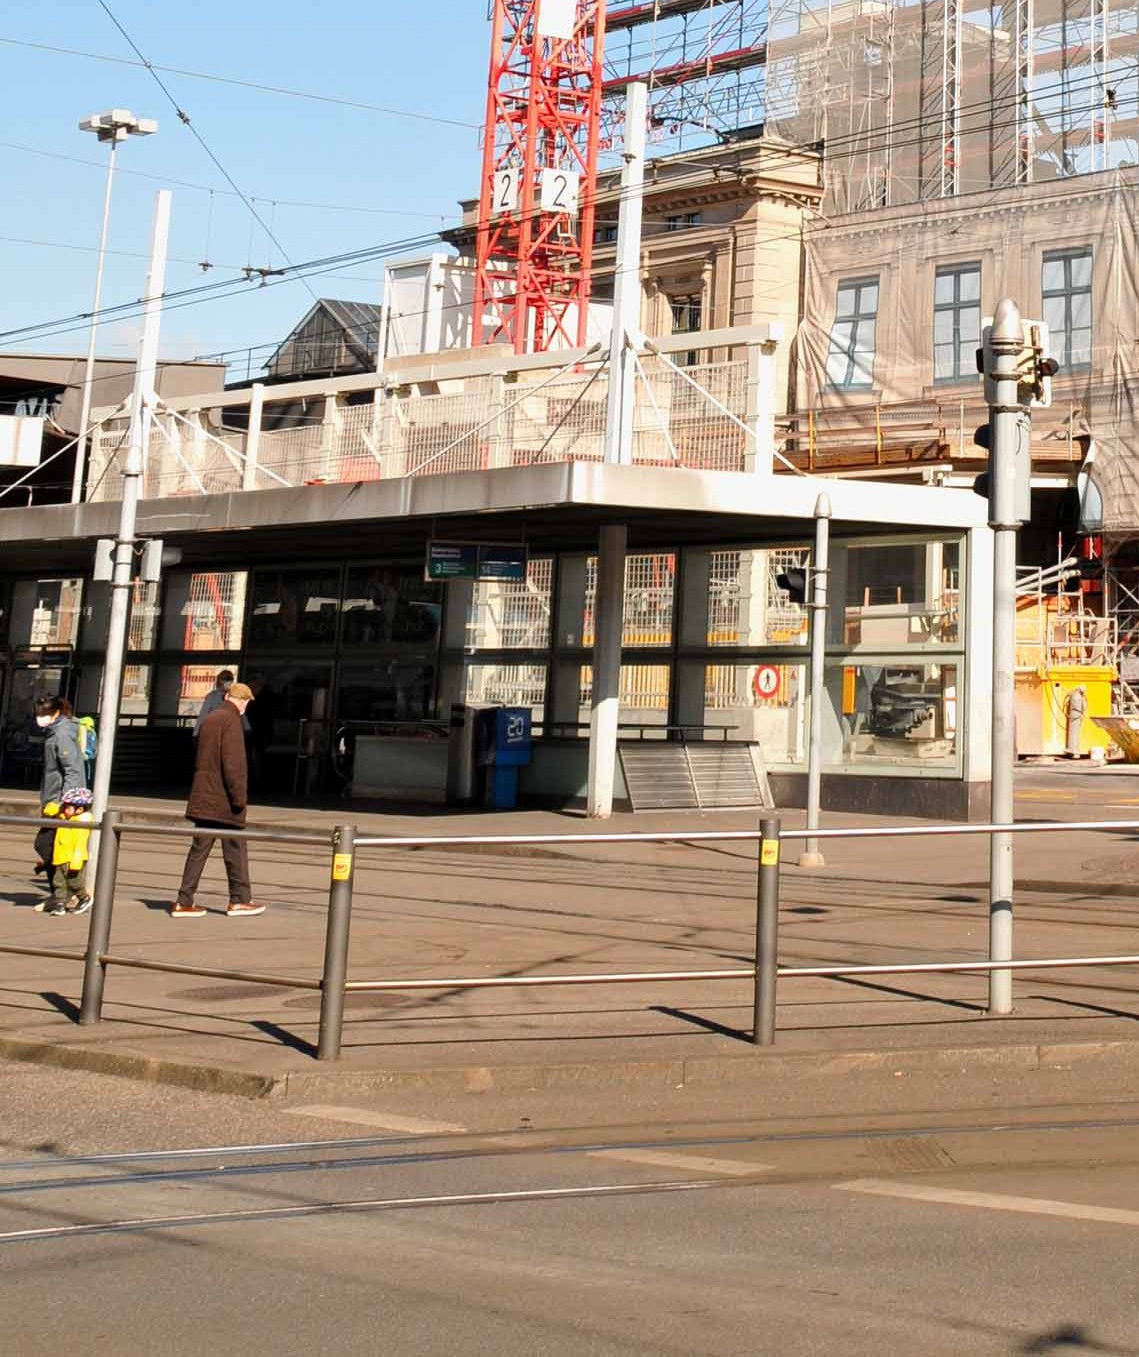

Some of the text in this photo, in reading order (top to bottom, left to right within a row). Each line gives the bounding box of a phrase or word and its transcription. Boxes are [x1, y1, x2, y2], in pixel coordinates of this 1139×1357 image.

[501, 174, 511, 207] 2
[553, 175, 567, 208] 2
[507, 717, 523, 737] 20
